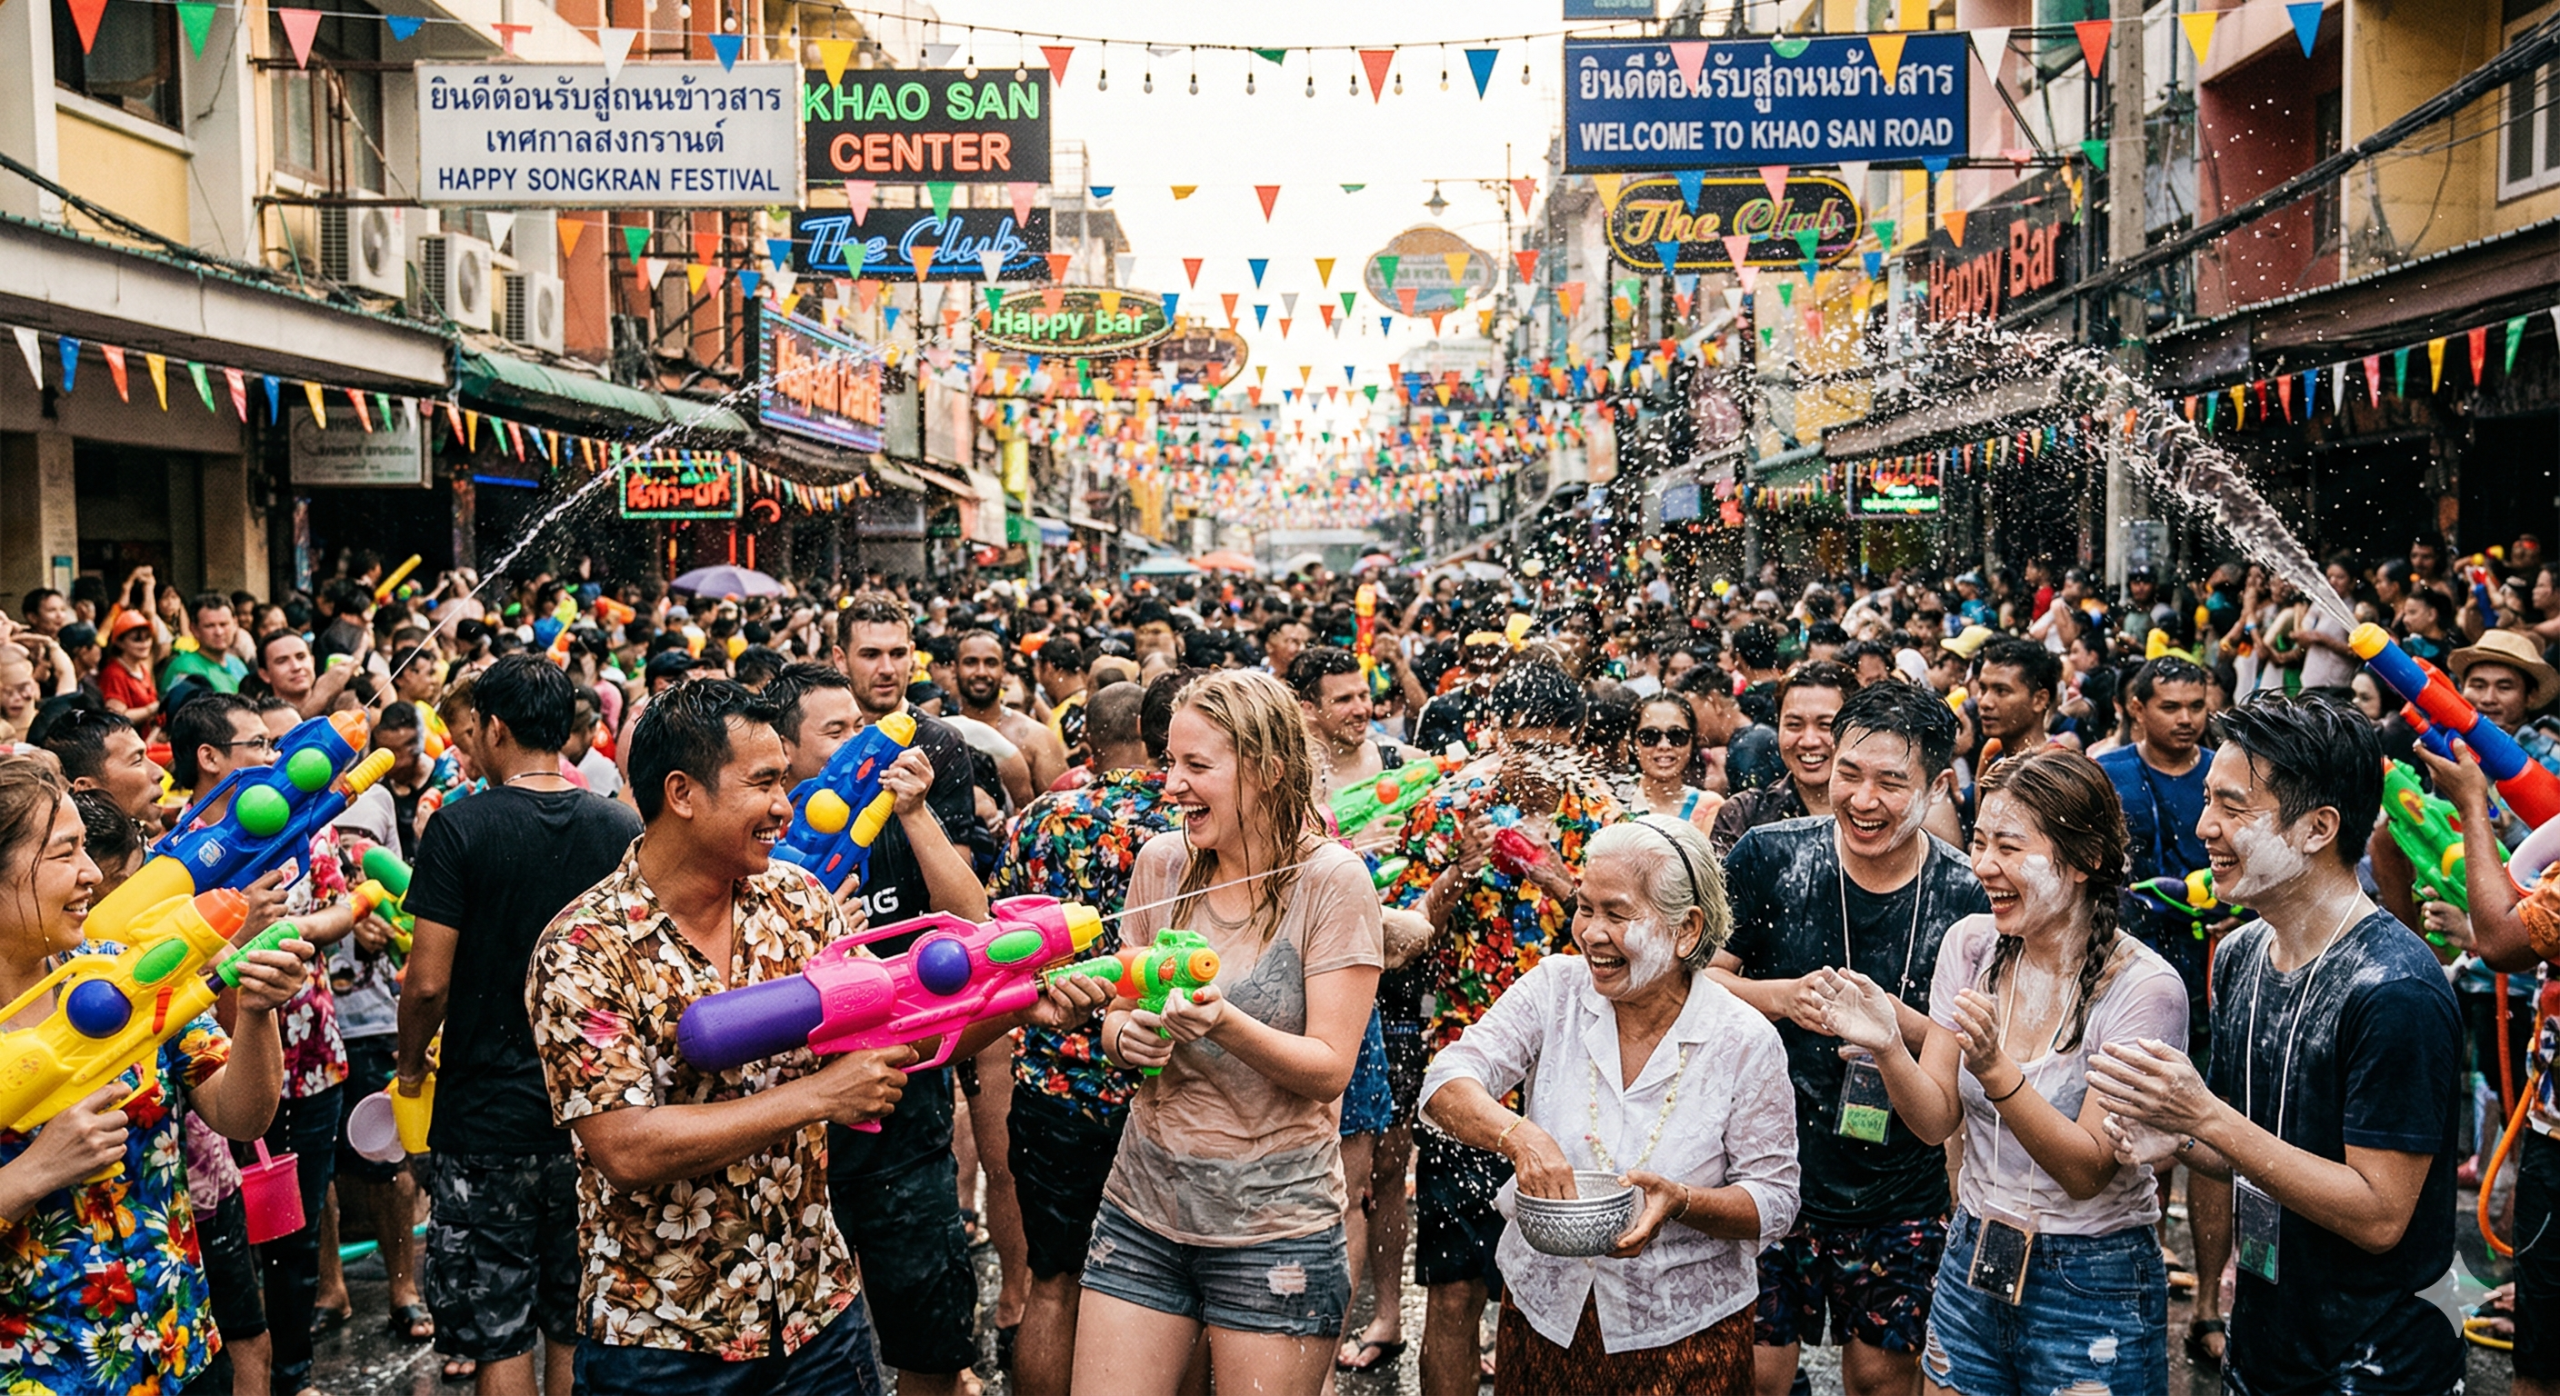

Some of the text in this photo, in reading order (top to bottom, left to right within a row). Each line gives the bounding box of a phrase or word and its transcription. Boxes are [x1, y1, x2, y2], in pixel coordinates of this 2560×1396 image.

[430, 74, 782, 122] ยินดีต้อนรับสู่ถนนข้าวสาร
[803, 81, 1040, 122] KHAO SAN
[486, 117, 726, 154] เทศกาลสงกรานต์
[829, 131, 1012, 173] CENTER
[1579, 117, 1954, 151] WELCOME TO KHAO SAN ROAD
[438, 167, 781, 193] HAPPY SONGKRAN FESTIVAL
[799, 214, 1028, 266] The Club
[1622, 198, 1845, 246] The Club
[2009, 218, 2061, 299] Bar
[992, 305, 1085, 340] Happy
